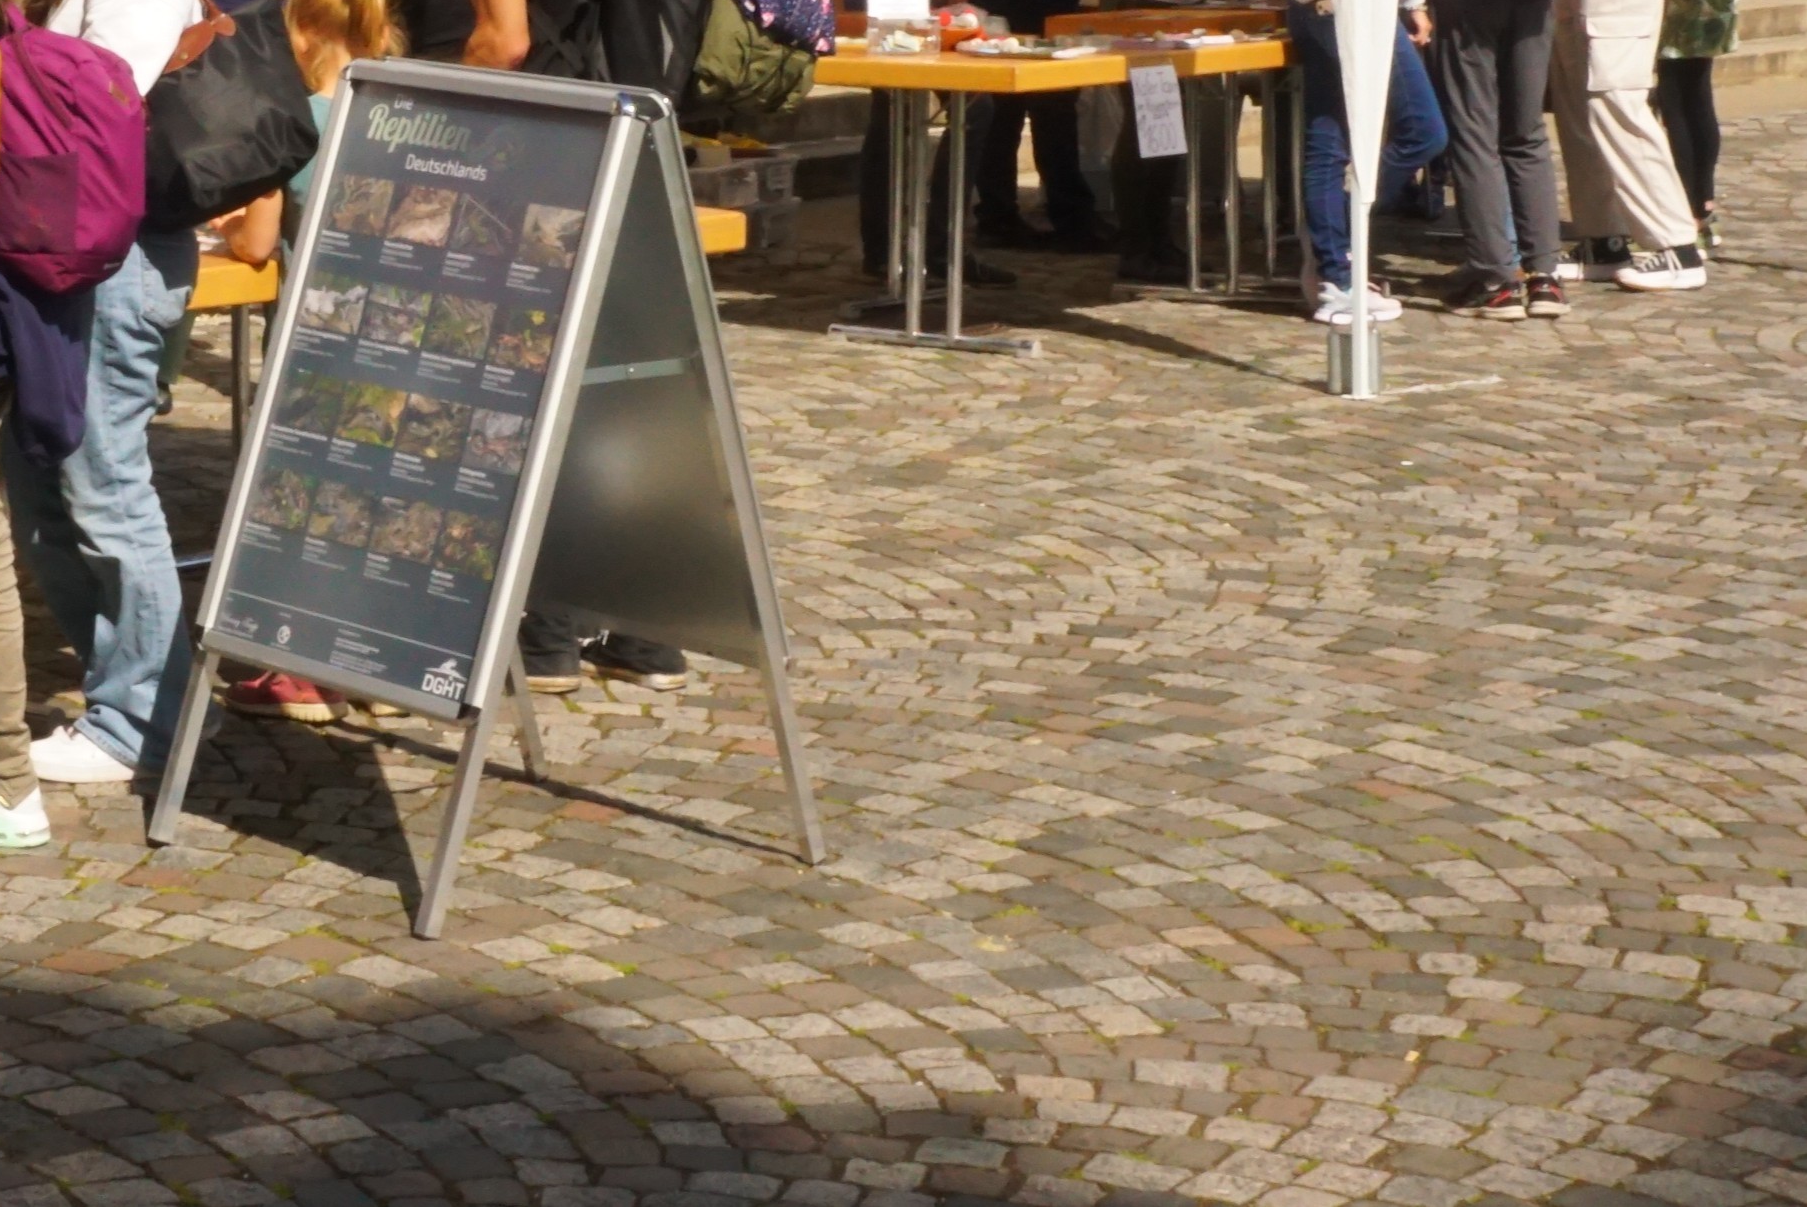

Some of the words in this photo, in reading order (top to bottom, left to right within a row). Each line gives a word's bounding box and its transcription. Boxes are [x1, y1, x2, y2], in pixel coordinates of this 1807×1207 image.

[394, 93, 413, 110] Die
[366, 102, 472, 153] Reptilien
[404, 153, 488, 182] Deutschlands
[421, 673, 465, 700] DGHT
